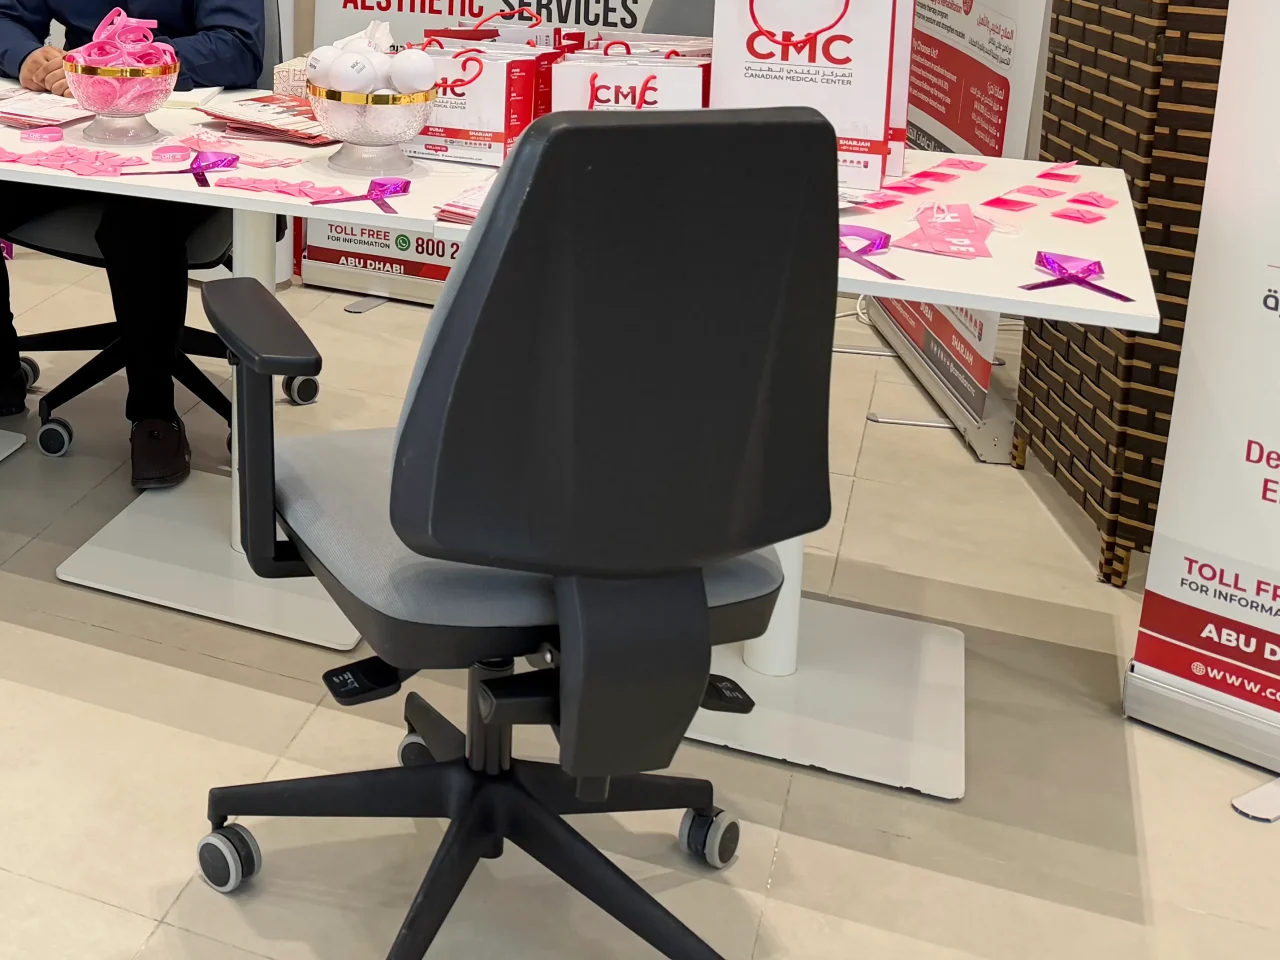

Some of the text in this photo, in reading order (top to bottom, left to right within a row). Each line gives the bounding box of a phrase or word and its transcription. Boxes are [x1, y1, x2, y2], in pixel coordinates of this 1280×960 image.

[746, 29, 853, 65] CMC
[595, 84, 658, 105] CMC
[744, 72, 852, 86] CANADIAN MEDICAL CENTER
[327, 223, 445, 258] TOLL FREE 800
[327, 234, 391, 250] FOR INFORMATION
[339, 256, 405, 274] ABU DHABI
[1245, 439, 1280, 469] De
[1184, 556, 1247, 593] TOLL
[1180, 578, 1280, 617] FOR INFORMA
[1200, 623, 1280, 661] ABU D
